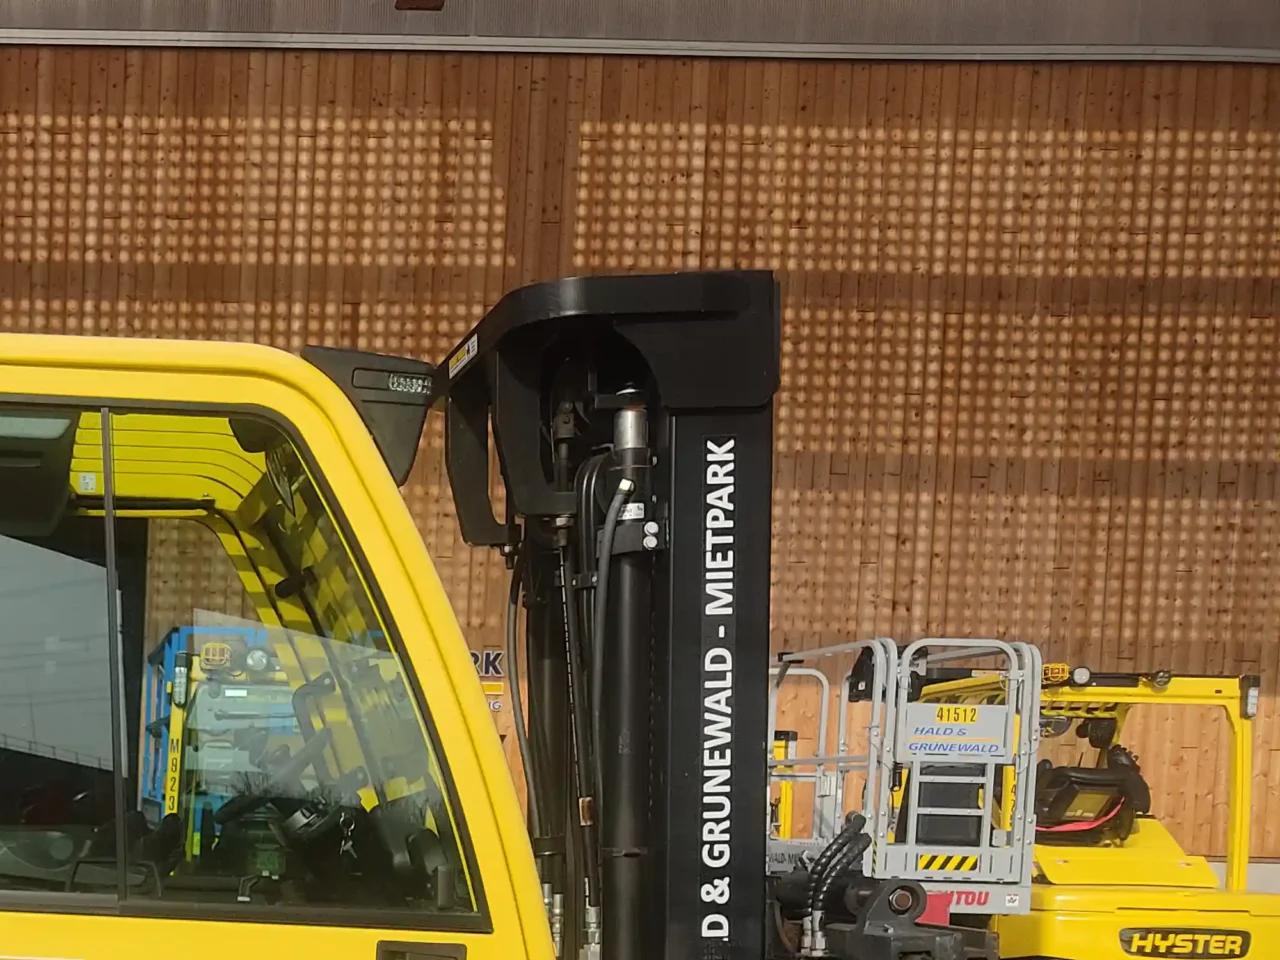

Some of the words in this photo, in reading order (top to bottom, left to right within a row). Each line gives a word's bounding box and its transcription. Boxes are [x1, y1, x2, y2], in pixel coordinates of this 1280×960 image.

[705, 439, 736, 616] MIETPARK
[718, 625, 726, 638] -
[936, 707, 977, 722] 41512
[914, 726, 954, 736] HALD
[956, 728, 968, 736] &
[908, 742, 999, 753] GRUNEWALD
[701, 647, 733, 868] GRUNEWALD
[701, 877, 731, 905] &
[1130, 933, 1243, 955] HYSTER
